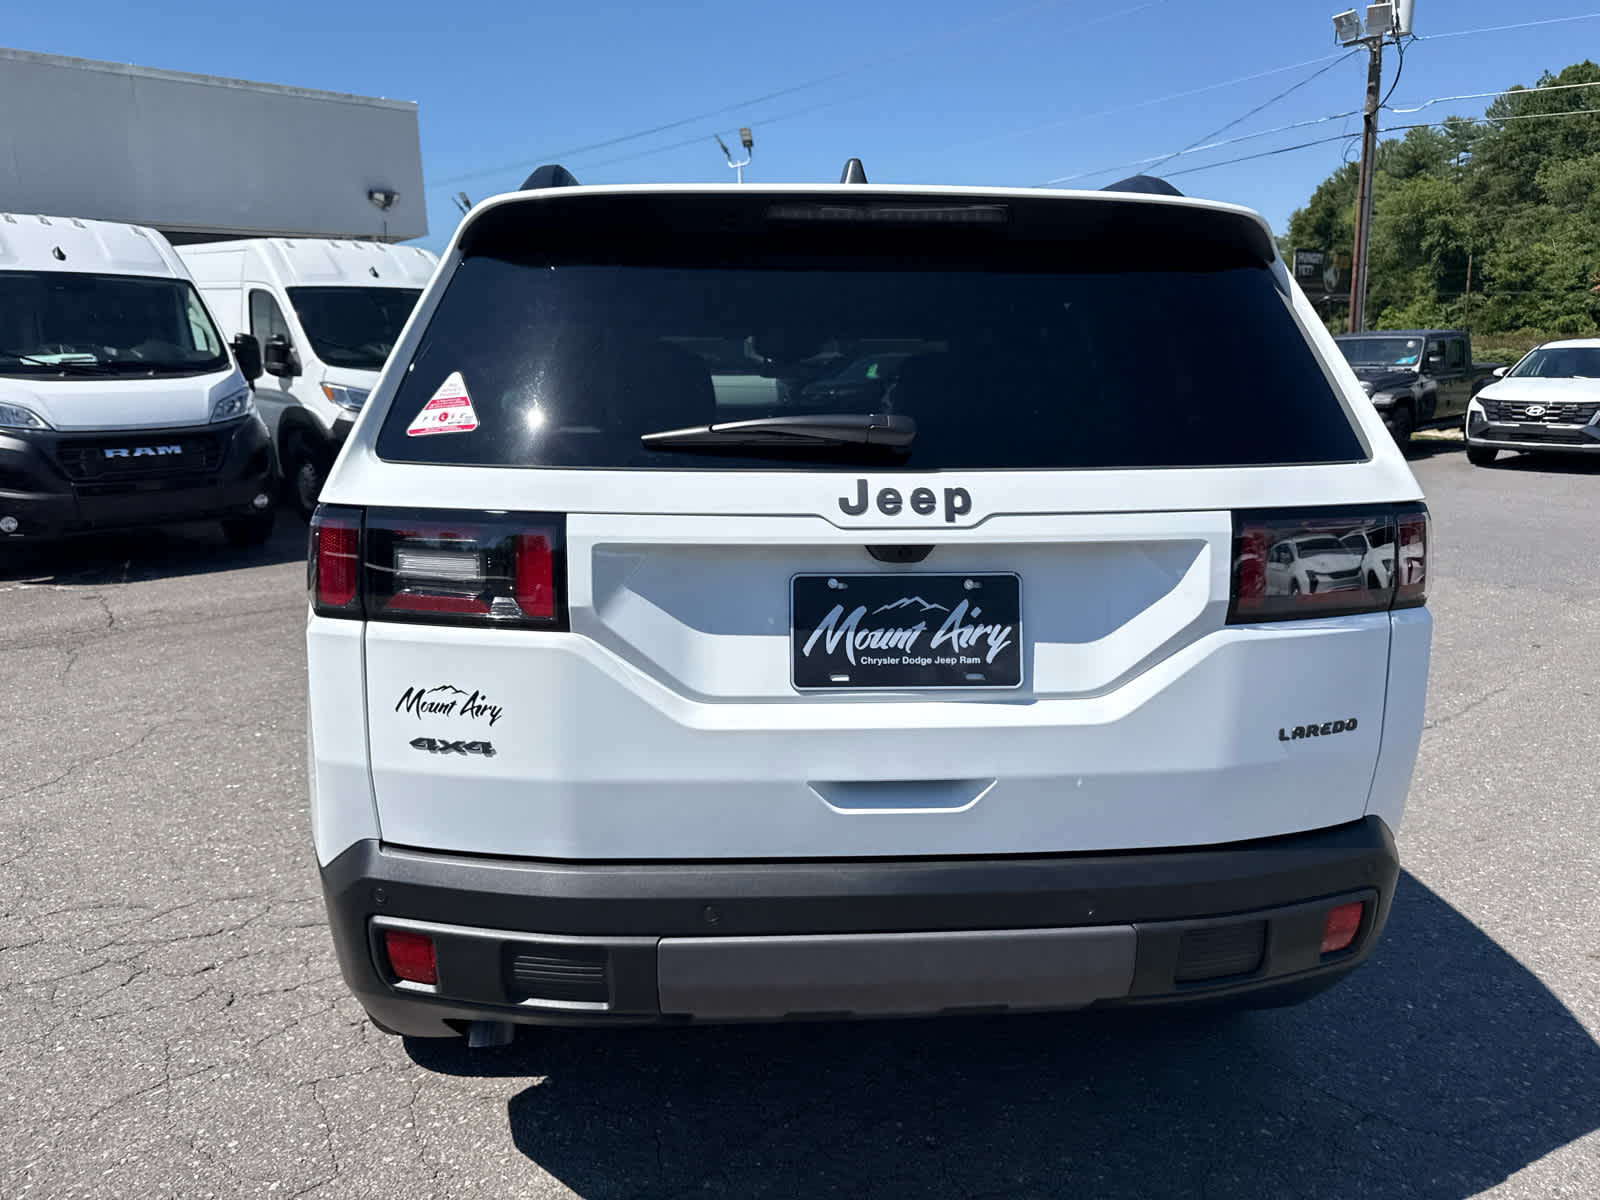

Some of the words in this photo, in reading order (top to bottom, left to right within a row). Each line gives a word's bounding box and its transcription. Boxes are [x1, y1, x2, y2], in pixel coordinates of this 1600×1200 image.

[103, 445, 182, 458] RAM
[838, 478, 972, 523] Jeep
[802, 604, 927, 666] Mount
[930, 598, 1012, 664] Airy
[860, 655, 900, 665] Chrysler
[902, 655, 932, 665] Dodge
[934, 655, 957, 665] Jeep
[960, 655, 981, 664] Ram
[395, 686, 457, 720] Mount
[459, 690, 503, 727] Airy
[1278, 717, 1358, 741] LAREDO
